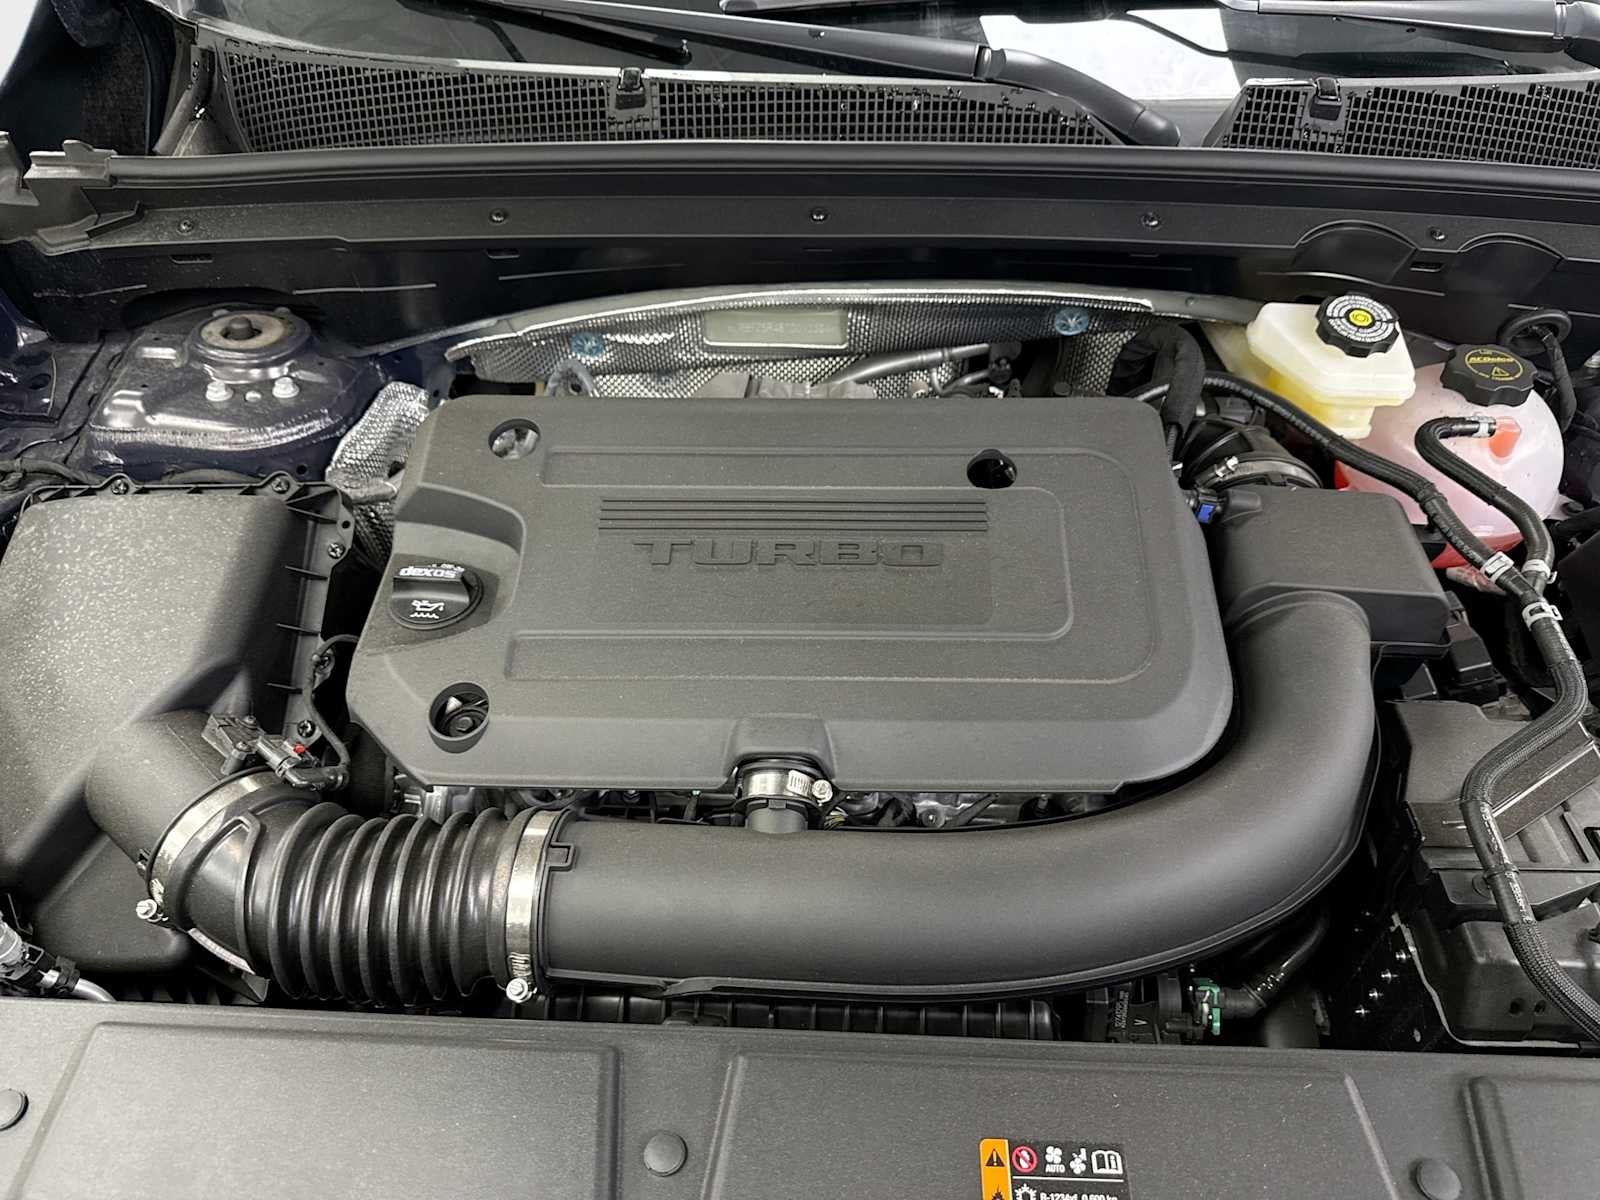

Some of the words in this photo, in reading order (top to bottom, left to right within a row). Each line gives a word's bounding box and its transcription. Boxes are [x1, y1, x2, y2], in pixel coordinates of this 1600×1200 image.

[632, 538, 943, 567] TURBO
[399, 566, 457, 579] dexos
[1045, 1164, 1066, 1173] AUTO
